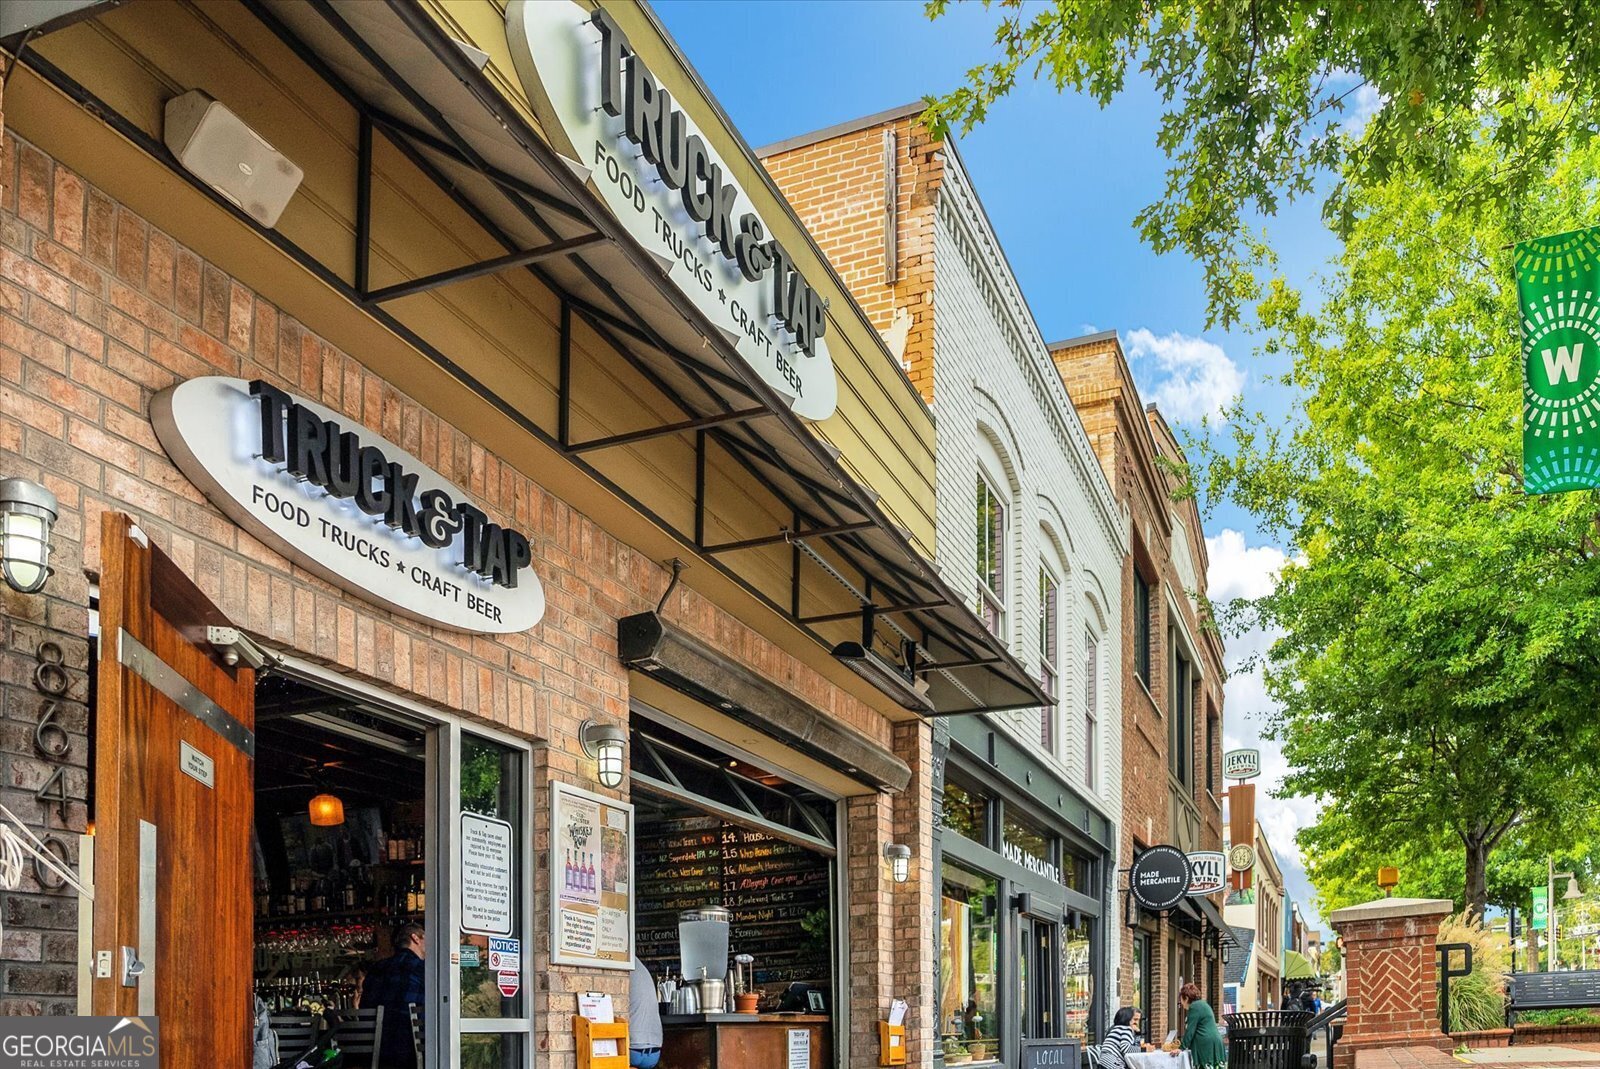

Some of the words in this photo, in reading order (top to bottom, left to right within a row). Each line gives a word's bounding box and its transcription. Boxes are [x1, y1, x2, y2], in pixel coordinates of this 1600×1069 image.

[594, 140, 647, 215] FOOD
[651, 205, 713, 292] TRUCKS
[730, 299, 772, 358] CRAFT
[775, 347, 804, 398] BEER
[1541, 342, 1585, 386] W
[252, 483, 311, 529] FOOD
[318, 517, 391, 568] TRUCKS
[410, 565, 462, 604] CRAFT
[466, 591, 503, 625] BEER
[191, 754, 204, 766] WATCH
[1227, 754, 1256, 768] JEKYLL
[188, 761, 198, 773] YOUR
[198, 767, 208, 778] STEP
[1002, 840, 1022, 866] MADE
[1024, 850, 1060, 884] MERCANTILE
[1140, 871, 1160, 879] MADE
[1140, 876, 1180, 886] MERCANTILE
[490, 940, 518, 952] NOTICE
[1036, 1049, 1065, 1065] LOCAL
